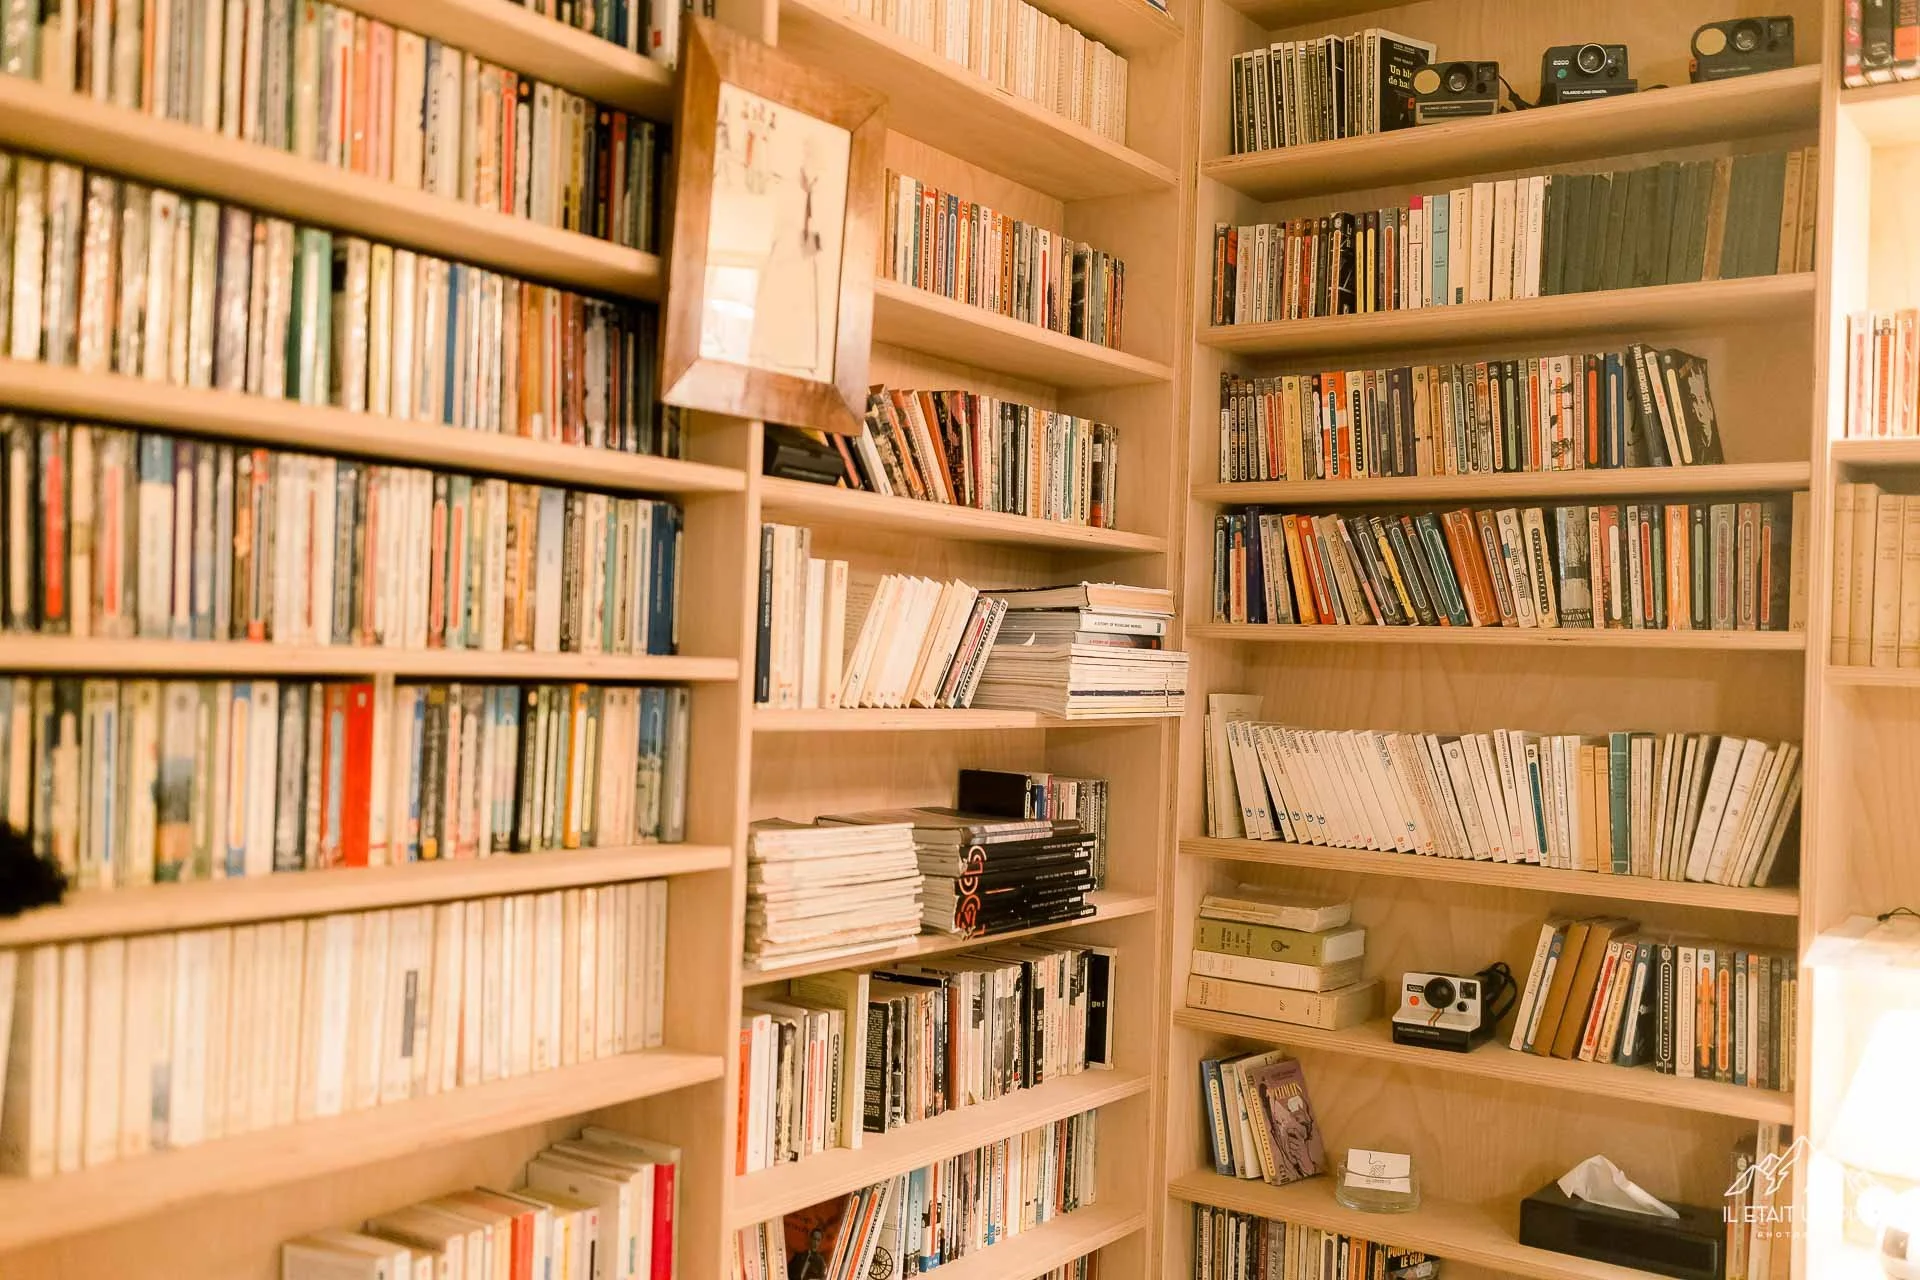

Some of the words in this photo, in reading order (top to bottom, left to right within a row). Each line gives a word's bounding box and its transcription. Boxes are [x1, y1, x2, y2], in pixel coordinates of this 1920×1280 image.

[1390, 64, 1401, 75] Un
[1388, 76, 1398, 86] de
[1401, 1256, 1409, 1268] LE
